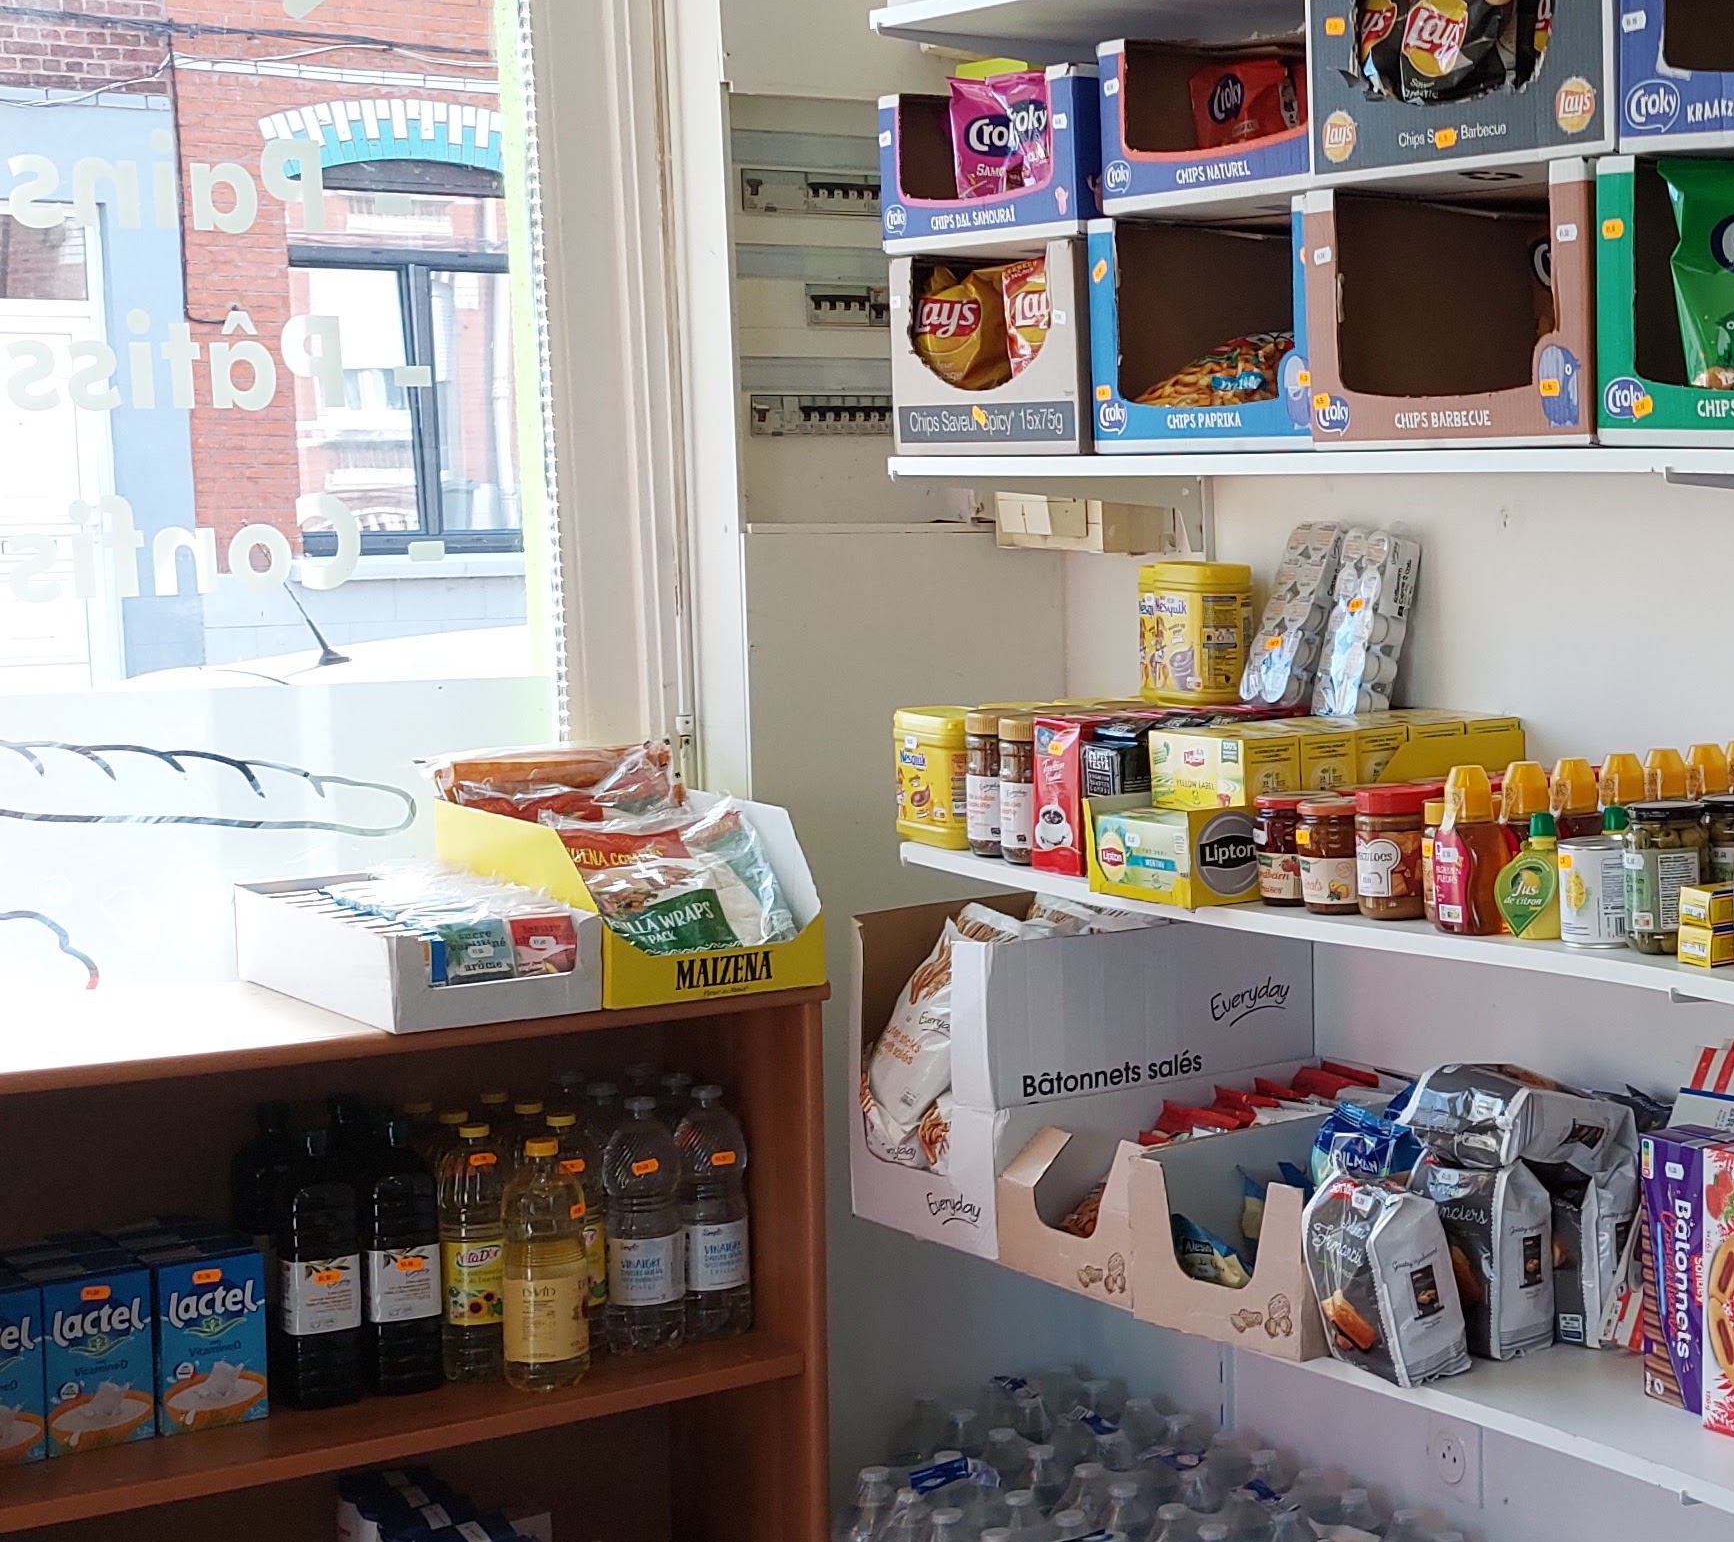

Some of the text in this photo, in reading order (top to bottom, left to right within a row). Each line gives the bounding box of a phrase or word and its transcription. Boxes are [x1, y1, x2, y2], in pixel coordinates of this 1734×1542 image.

[1630, 86, 1677, 123] Croky
[1176, 160, 1250, 184] CHIPS NATUREL
[915, 298, 978, 338] Lay's
[910, 412, 1063, 435] Chips 15x75g
[1168, 412, 1242, 429] CHIPS PAPRIKA
[1395, 409, 1491, 430] CHIPS BARBECUE
[1204, 833, 1256, 863] Lipton
[661, 901, 714, 928] WRAPS
[675, 951, 773, 989] MAIZENA
[1210, 977, 1289, 1021] Everyday
[1022, 1049, 1201, 1098] Bâtonnets salés
[926, 1192, 981, 1222] Everyday
[1673, 1199, 1691, 1359] Bâtonnets
[54, 1299, 145, 1338] lactel
[168, 1282, 257, 1321] lactel
